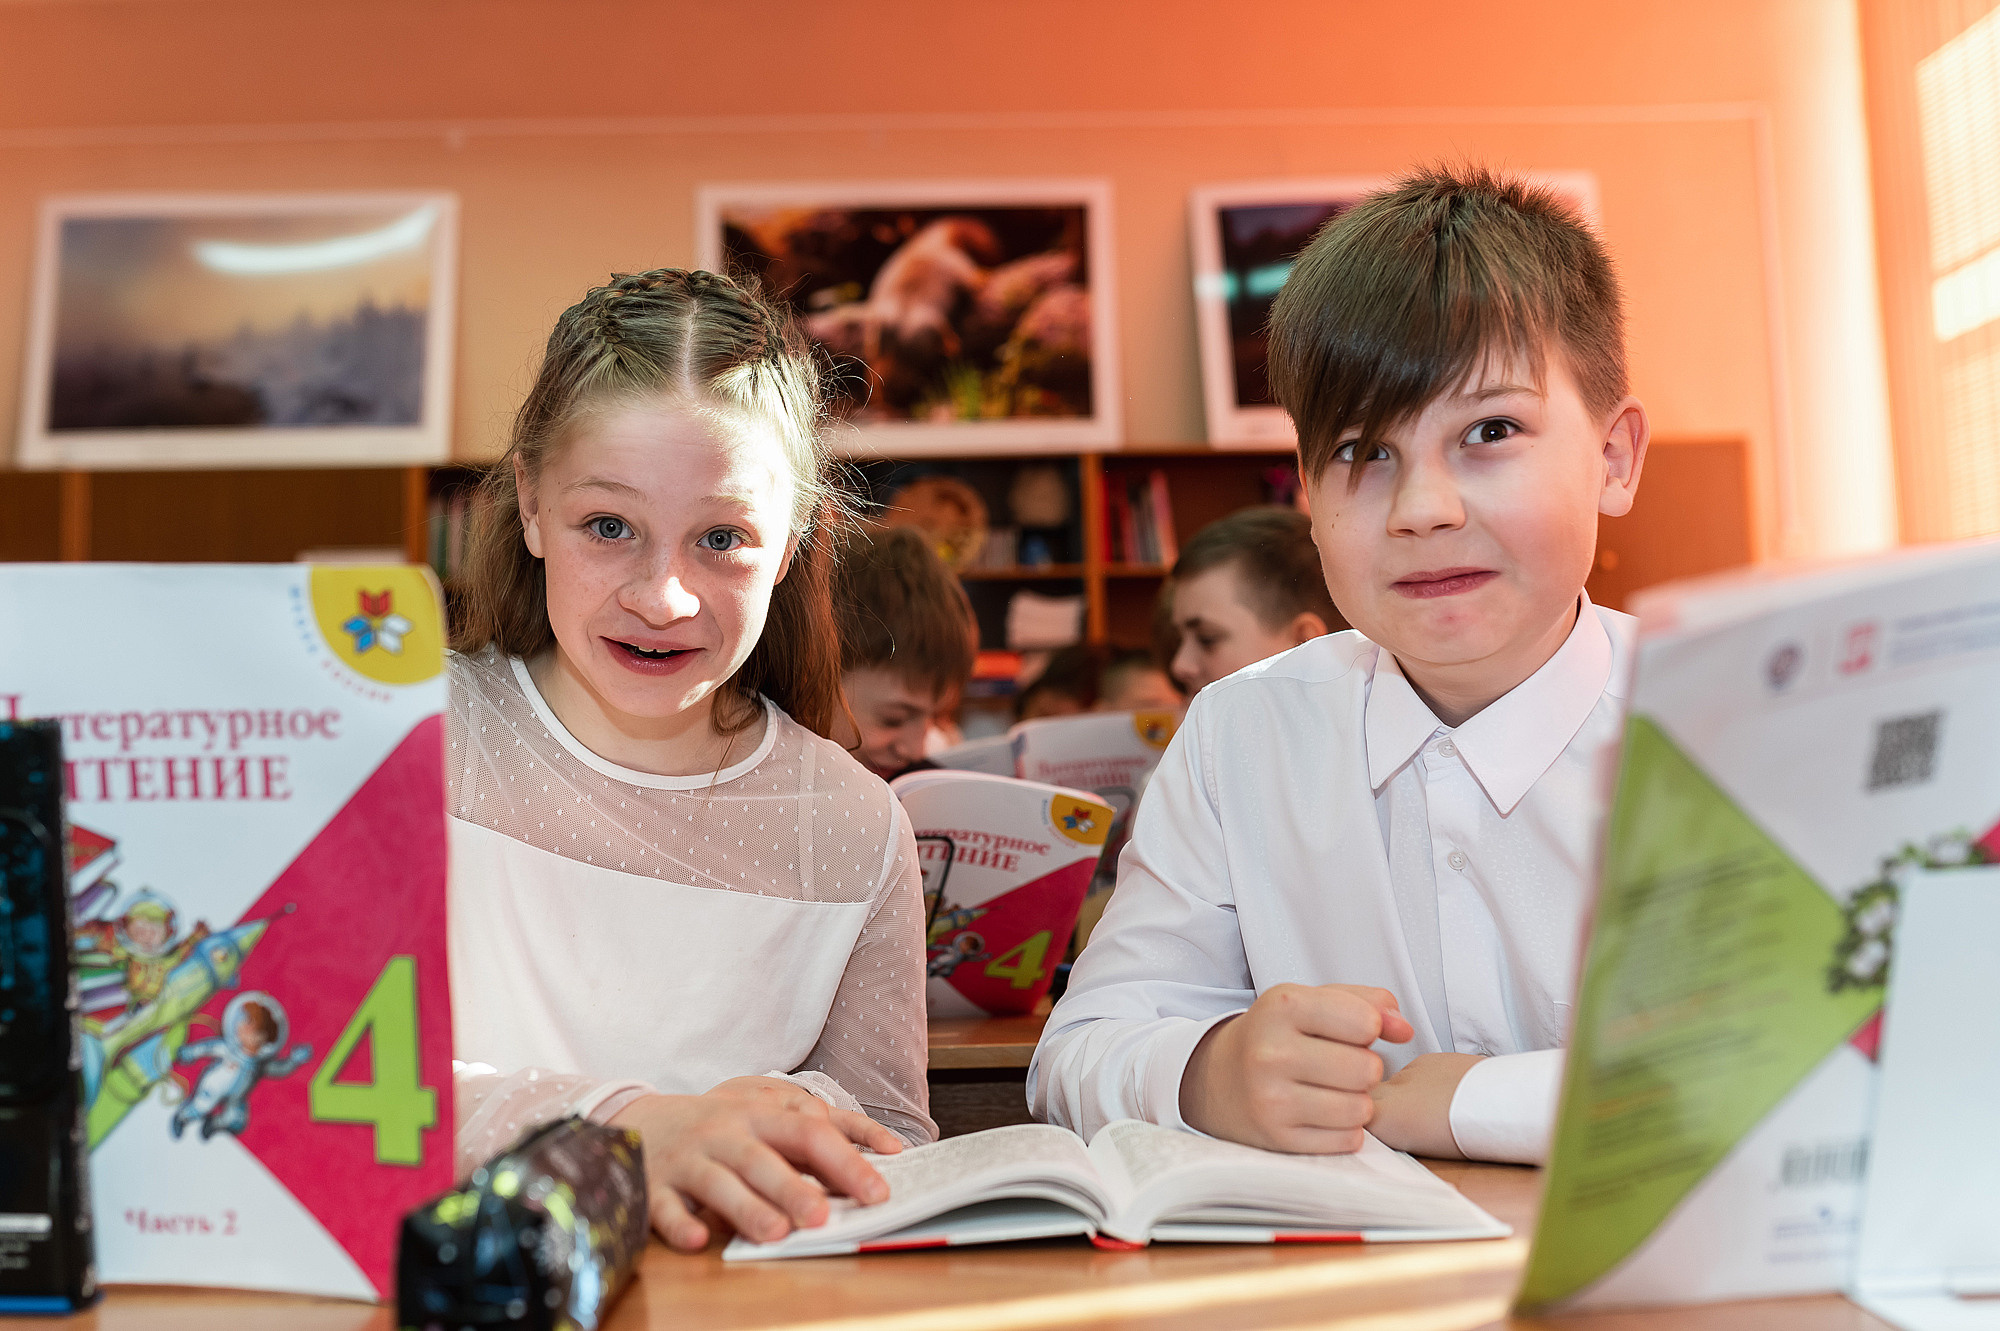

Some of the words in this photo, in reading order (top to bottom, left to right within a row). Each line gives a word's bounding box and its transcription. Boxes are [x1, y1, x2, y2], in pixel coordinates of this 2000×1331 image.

[0, 692, 342, 752] тературное
[62, 756, 294, 802] ТЕНИЕ
[917, 844, 1021, 872] ТЕНИЕ
[983, 930, 1052, 989] 4
[308, 955, 438, 1166] 4
[222, 1208, 240, 1236] 2
